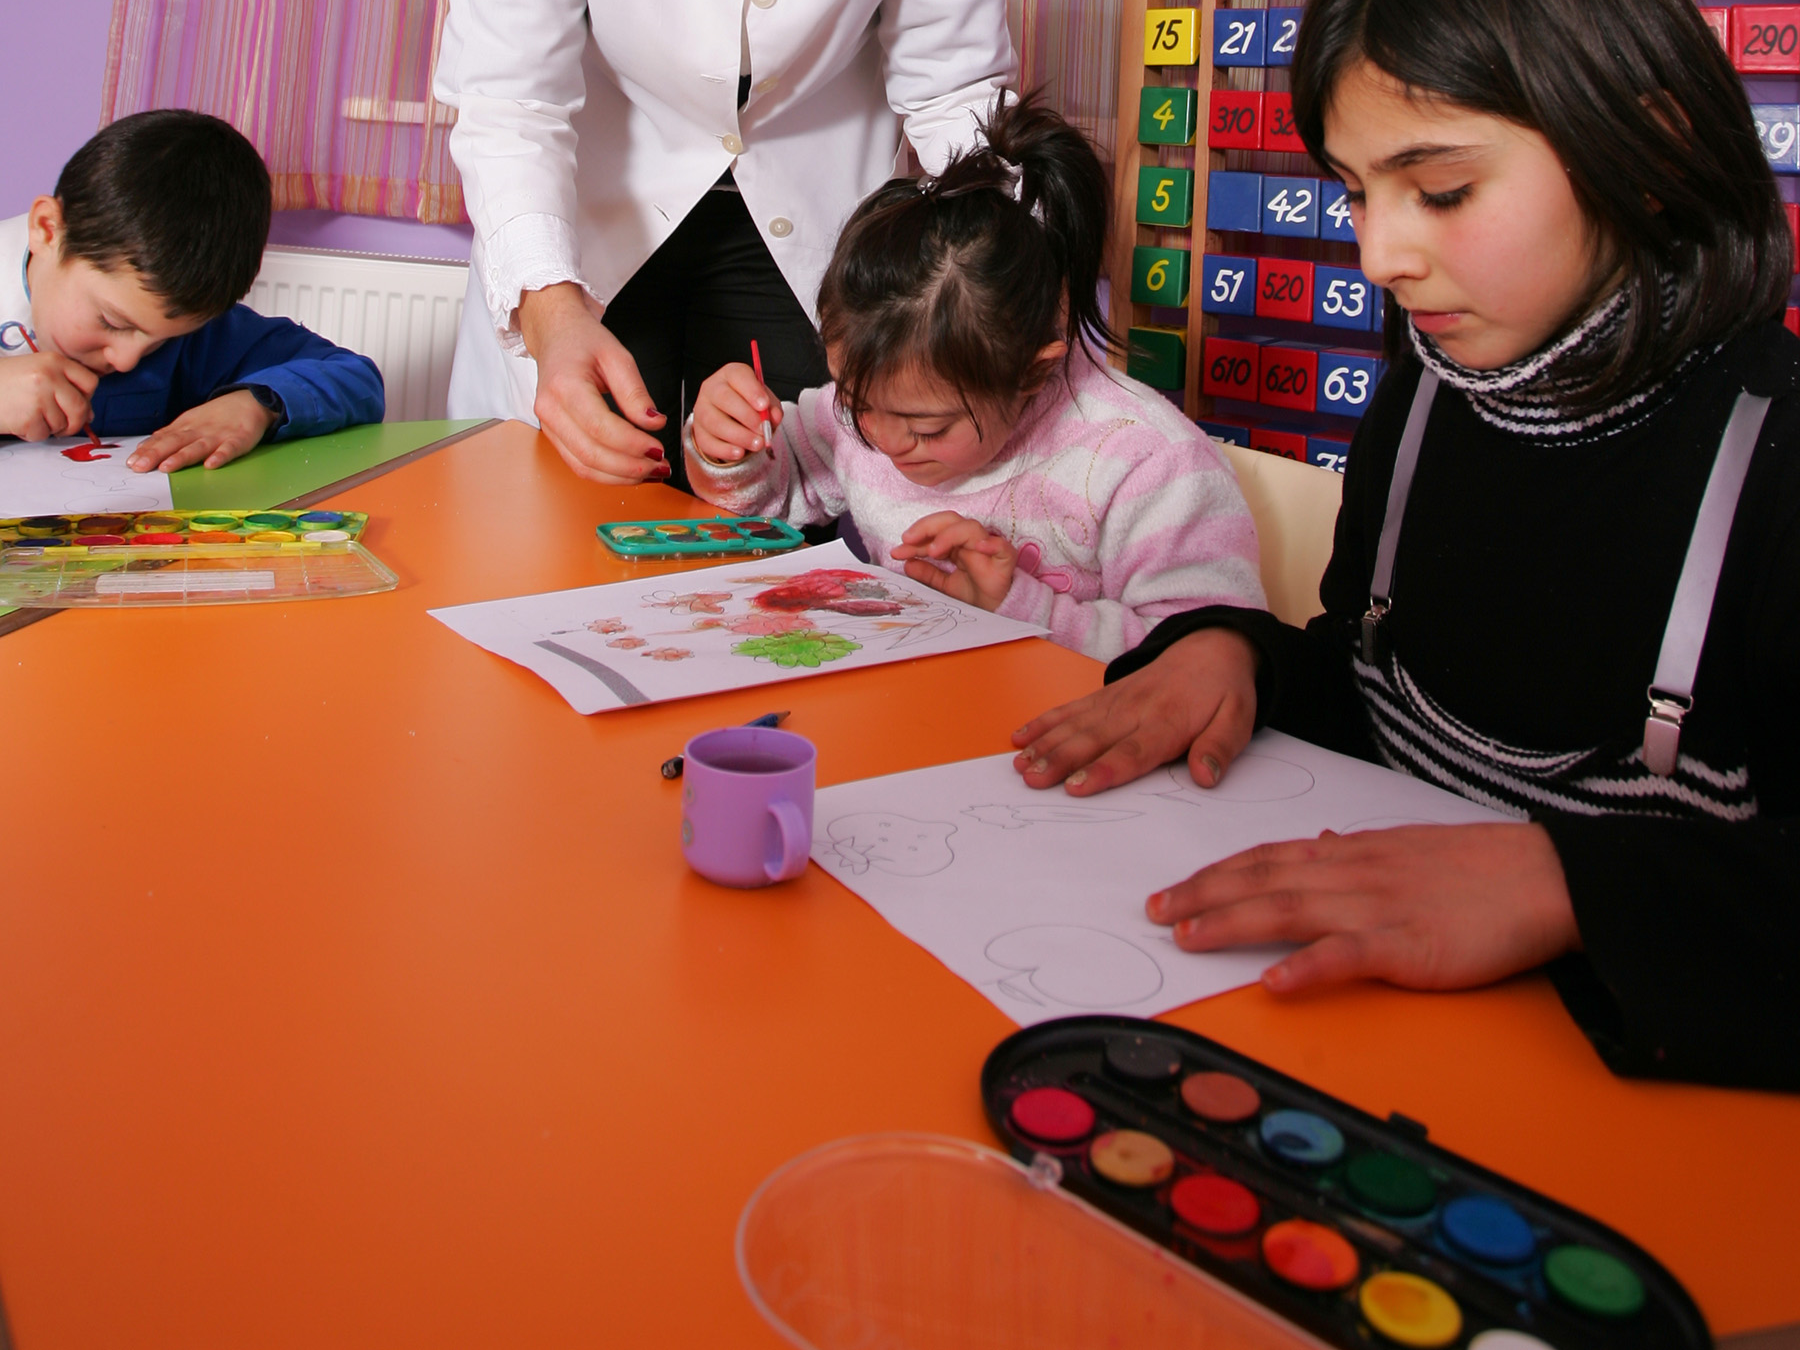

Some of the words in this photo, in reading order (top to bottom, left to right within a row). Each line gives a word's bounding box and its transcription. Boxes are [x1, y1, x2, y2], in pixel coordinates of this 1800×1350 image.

[1152, 19, 1182, 50] 15
[1220, 22, 1256, 54] 21
[1272, 19, 1297, 52] 2
[1743, 24, 1798, 55] 290
[1153, 99, 1174, 131] 4
[1213, 107, 1255, 134] 310
[1270, 110, 1296, 135] 32
[1151, 180, 1174, 212] 5
[1267, 189, 1312, 223] 42
[1146, 260, 1170, 291] 6
[1211, 269, 1245, 303] 51
[1262, 276, 1305, 302] 520
[1322, 280, 1367, 318] 53
[1210, 356, 1252, 382] 610
[1265, 366, 1308, 395] 620
[1324, 367, 1370, 404] 63
